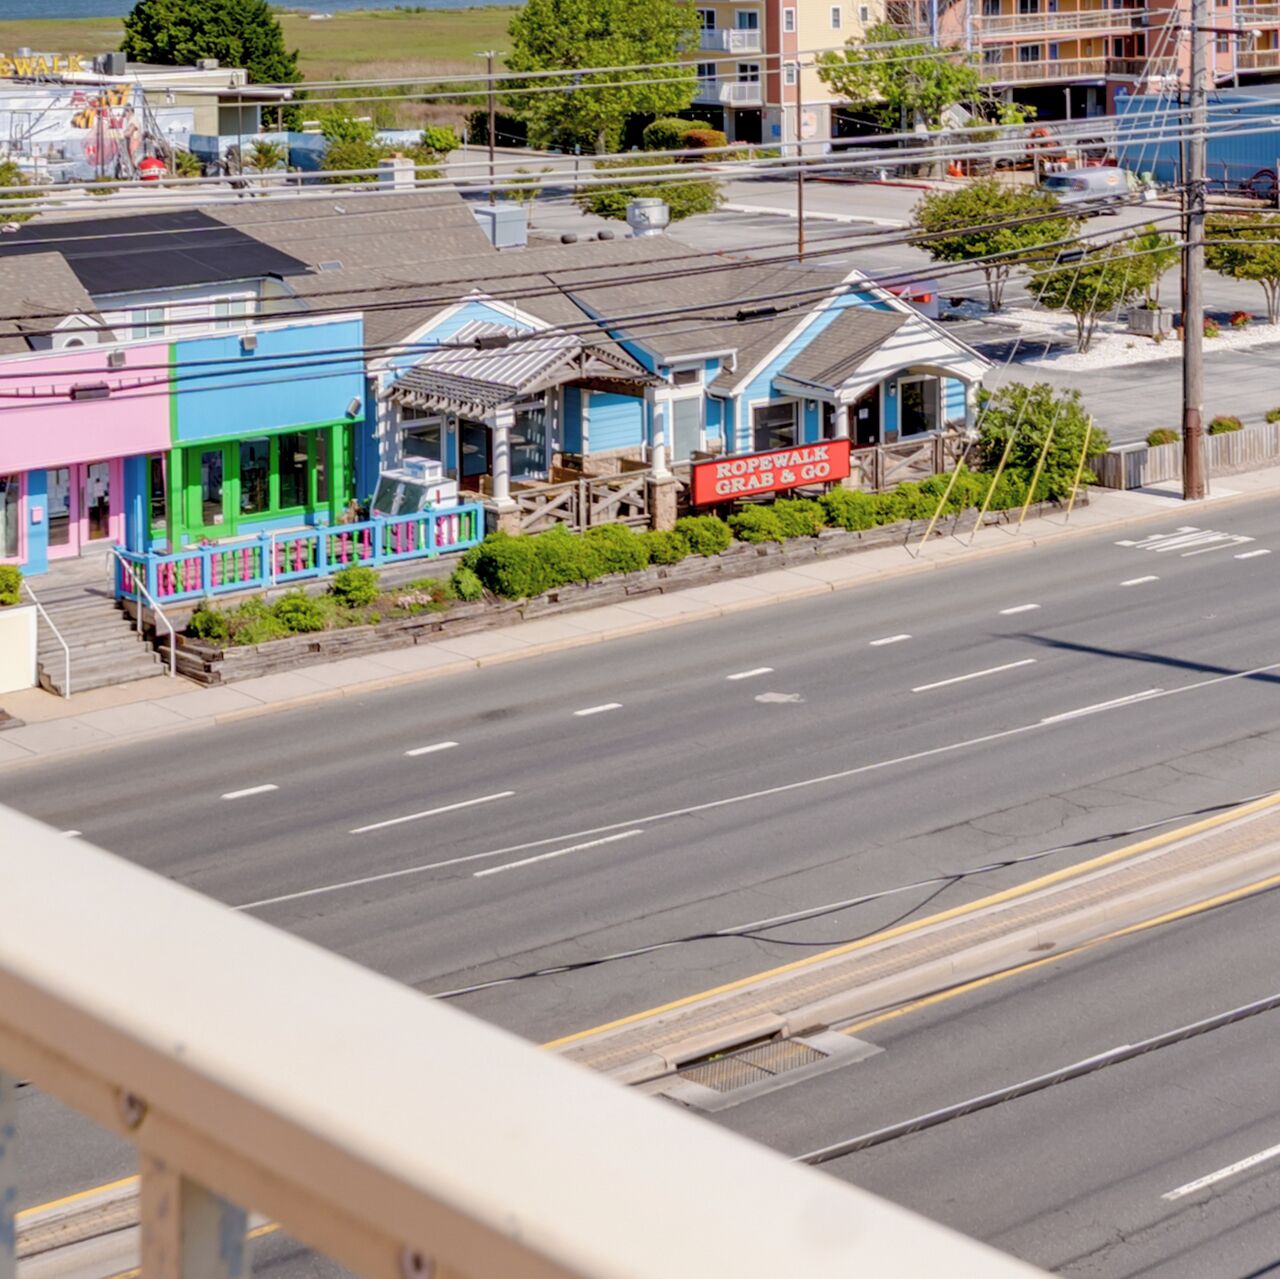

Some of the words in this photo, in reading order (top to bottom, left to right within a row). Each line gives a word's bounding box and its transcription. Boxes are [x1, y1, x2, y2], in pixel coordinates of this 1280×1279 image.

[715, 471, 774, 495] GRAB
[780, 469, 796, 484] &
[801, 462, 830, 480] GO
[716, 446, 829, 479] ROPEWALK
